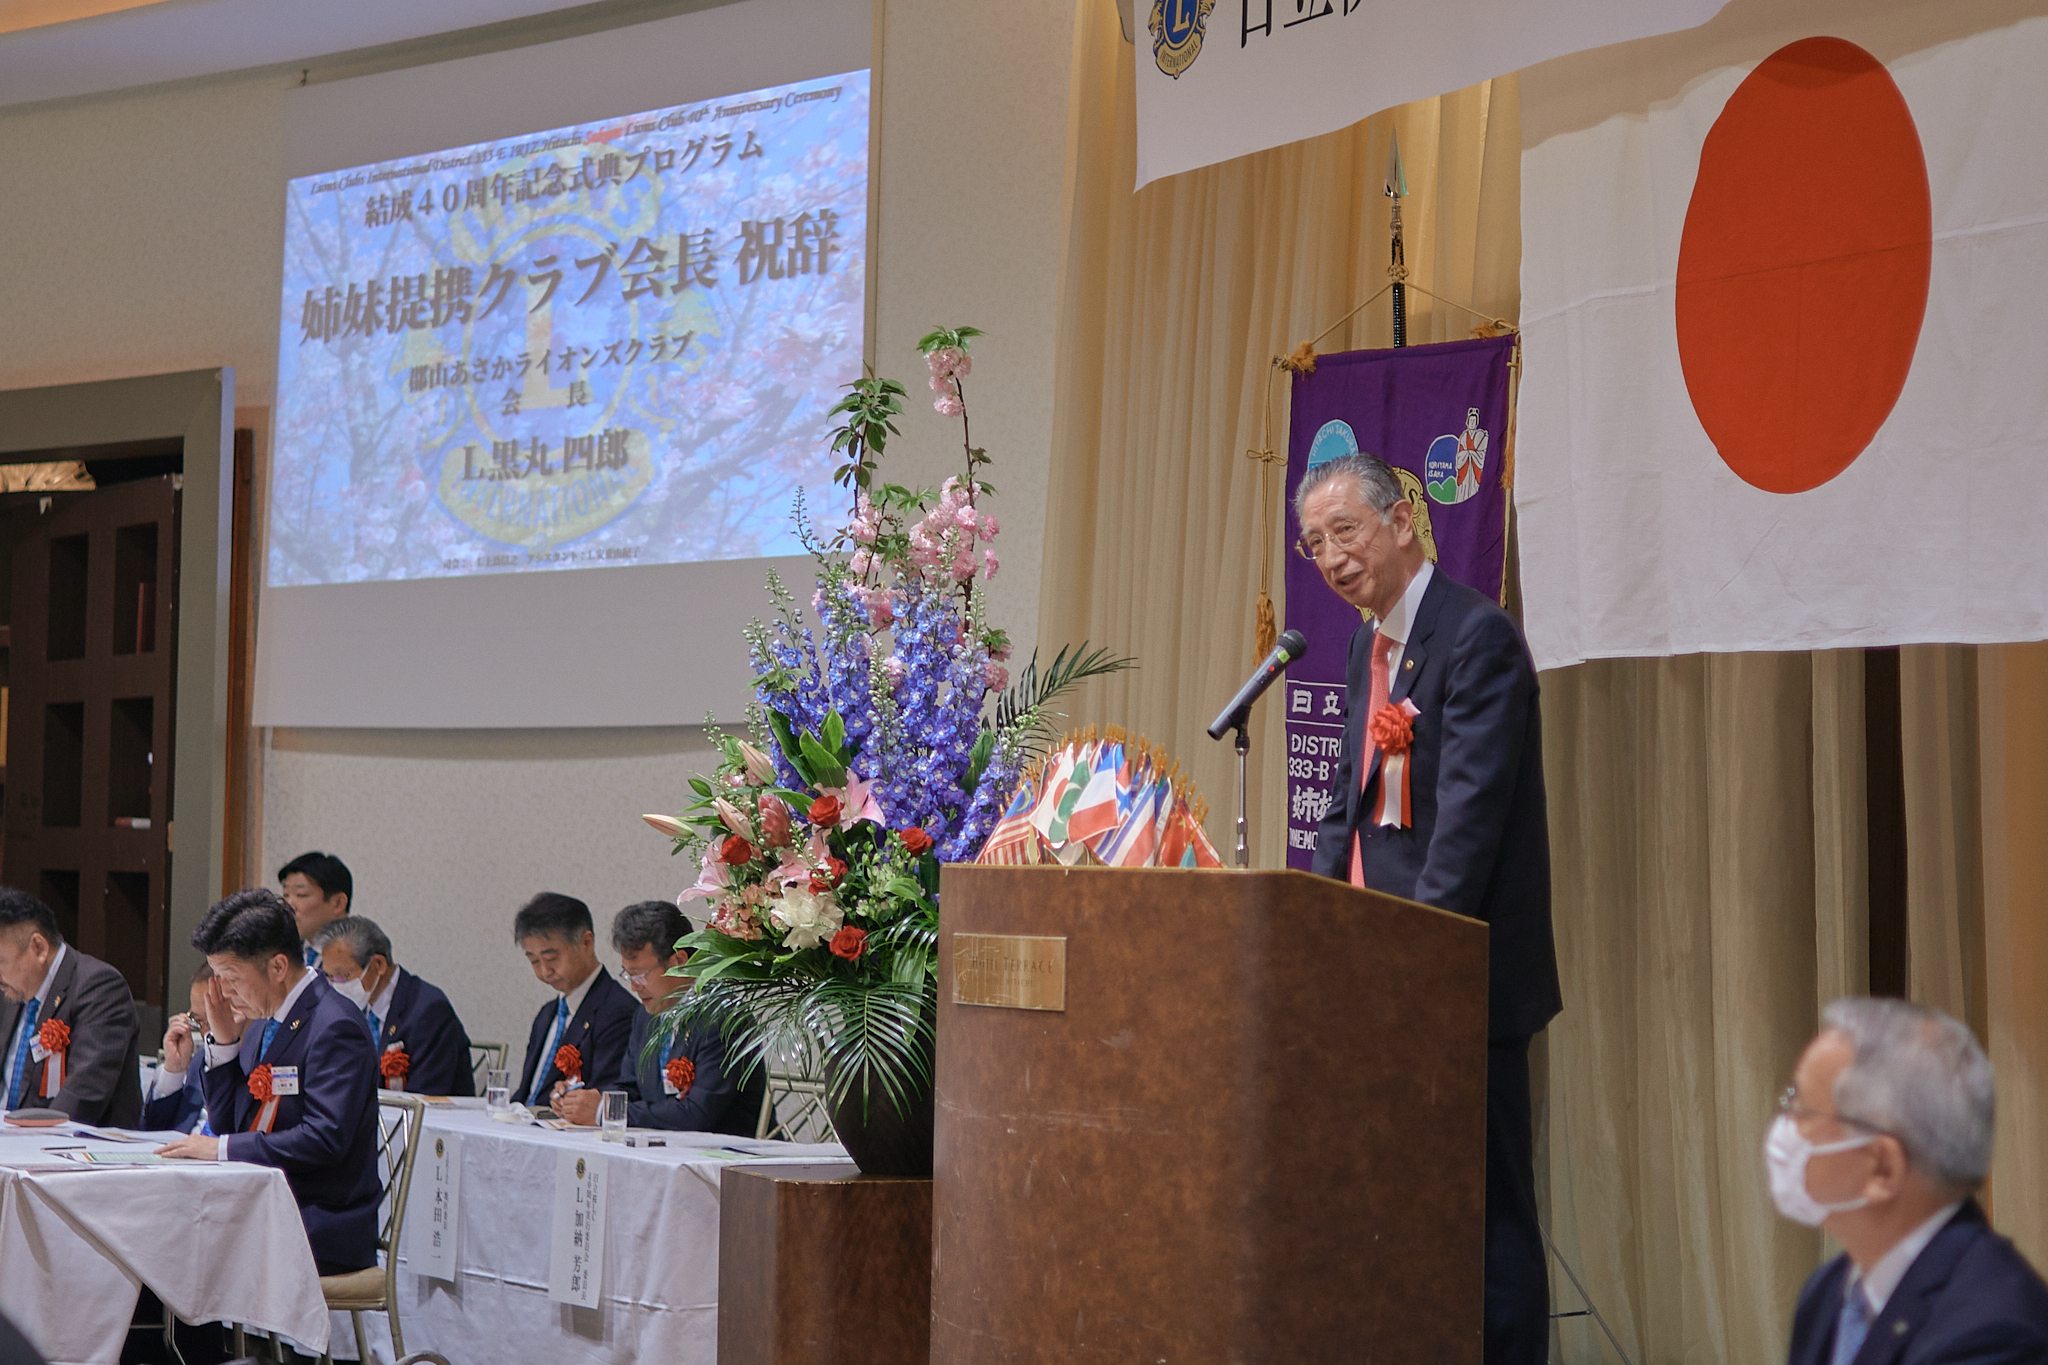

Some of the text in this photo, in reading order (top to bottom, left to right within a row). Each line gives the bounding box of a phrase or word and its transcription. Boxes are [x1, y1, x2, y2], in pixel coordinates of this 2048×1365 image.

[311, 181, 337, 195] Lions
[338, 176, 365, 191] Clubs
[367, 158, 431, 184] International
[624, 120, 657, 136] Lions
[658, 113, 685, 130] Club
[710, 97, 783, 122] Anniversary
[784, 85, 843, 108] Ceremony
[734, 208, 840, 285] 祝辞
[1289, 756, 1330, 781] 333-B
